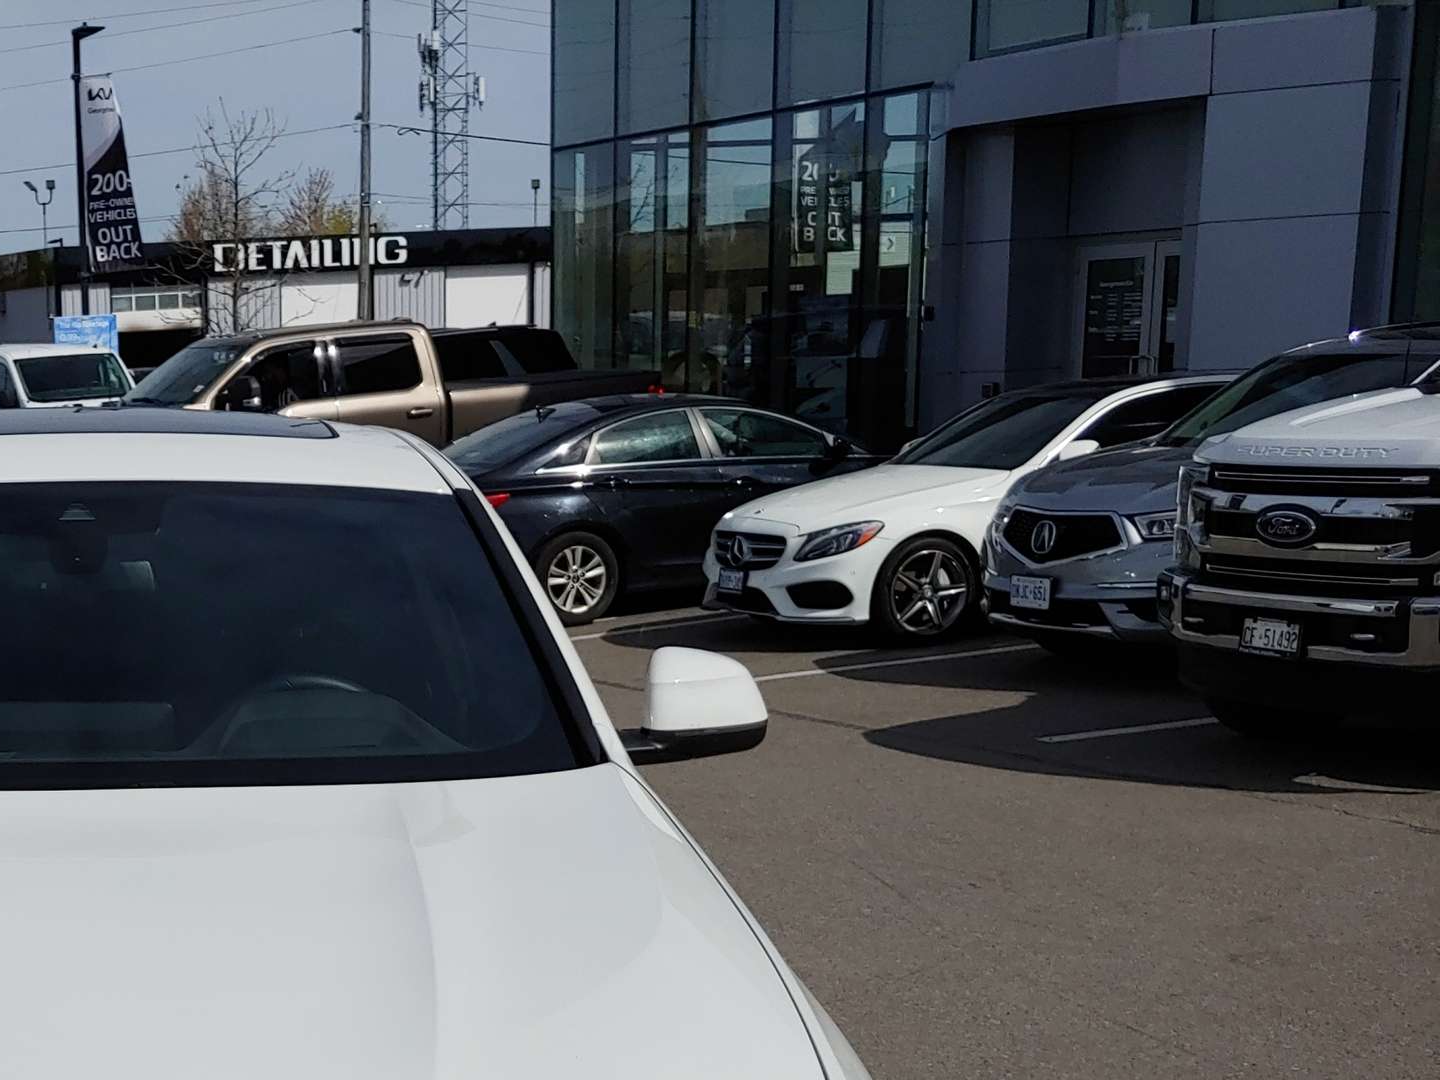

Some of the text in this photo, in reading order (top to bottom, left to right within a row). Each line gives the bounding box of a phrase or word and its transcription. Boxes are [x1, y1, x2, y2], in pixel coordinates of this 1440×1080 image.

[97, 225, 133, 244] OUT
[95, 241, 142, 262] BACK
[1319, 447, 1400, 459] DUTY
[1267, 516, 1300, 536] Ford
